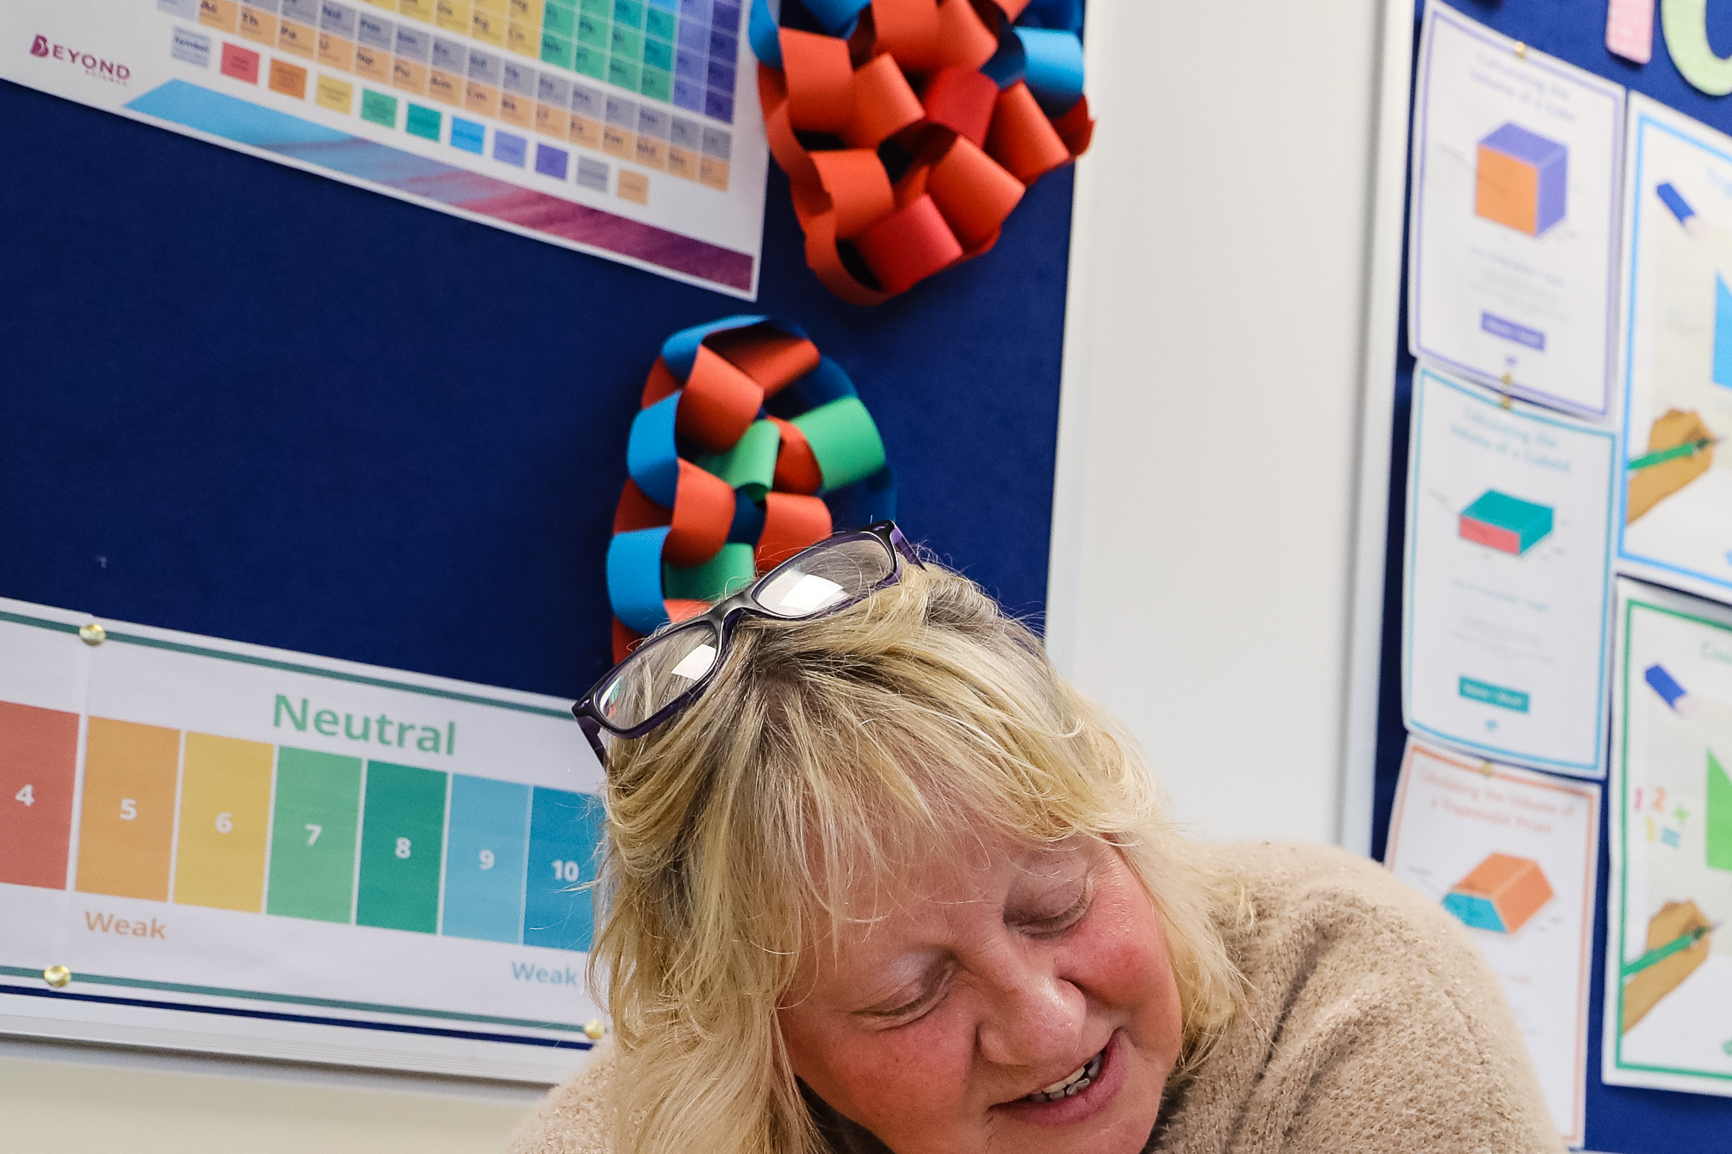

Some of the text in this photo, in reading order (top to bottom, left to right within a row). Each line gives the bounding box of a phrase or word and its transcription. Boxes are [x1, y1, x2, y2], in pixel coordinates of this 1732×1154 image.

[30, 33, 131, 80] BEYOND
[273, 693, 456, 756] Neutral
[15, 784, 579, 882] 4 5 6 7 8 9 10
[85, 911, 167, 940] Weak
[511, 961, 578, 986] Weak
